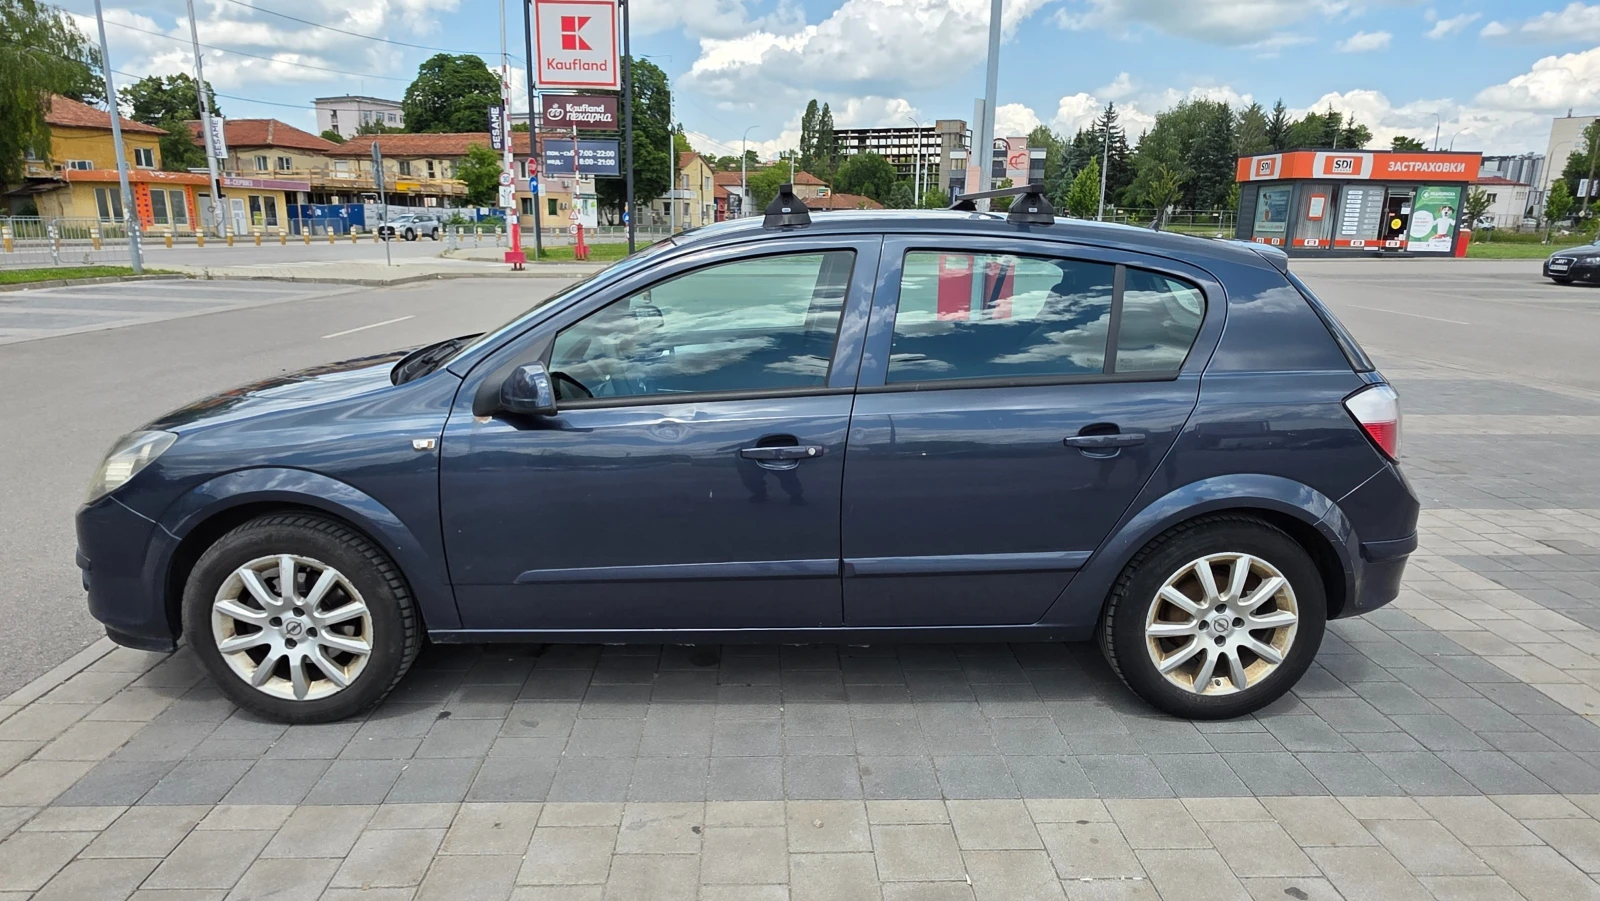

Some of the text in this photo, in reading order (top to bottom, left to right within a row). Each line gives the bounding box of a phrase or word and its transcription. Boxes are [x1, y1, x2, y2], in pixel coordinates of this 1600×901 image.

[547, 58, 607, 71] Kaufland
[566, 103, 604, 112] Kaufland
[566, 112, 612, 123] пекарна
[491, 107, 501, 149] SESAME
[212, 120, 222, 156] SESAME
[1260, 162, 1271, 171] SDI
[1334, 160, 1352, 169] SDI
[1387, 161, 1466, 173] ЗАСТРАХОВКИ
